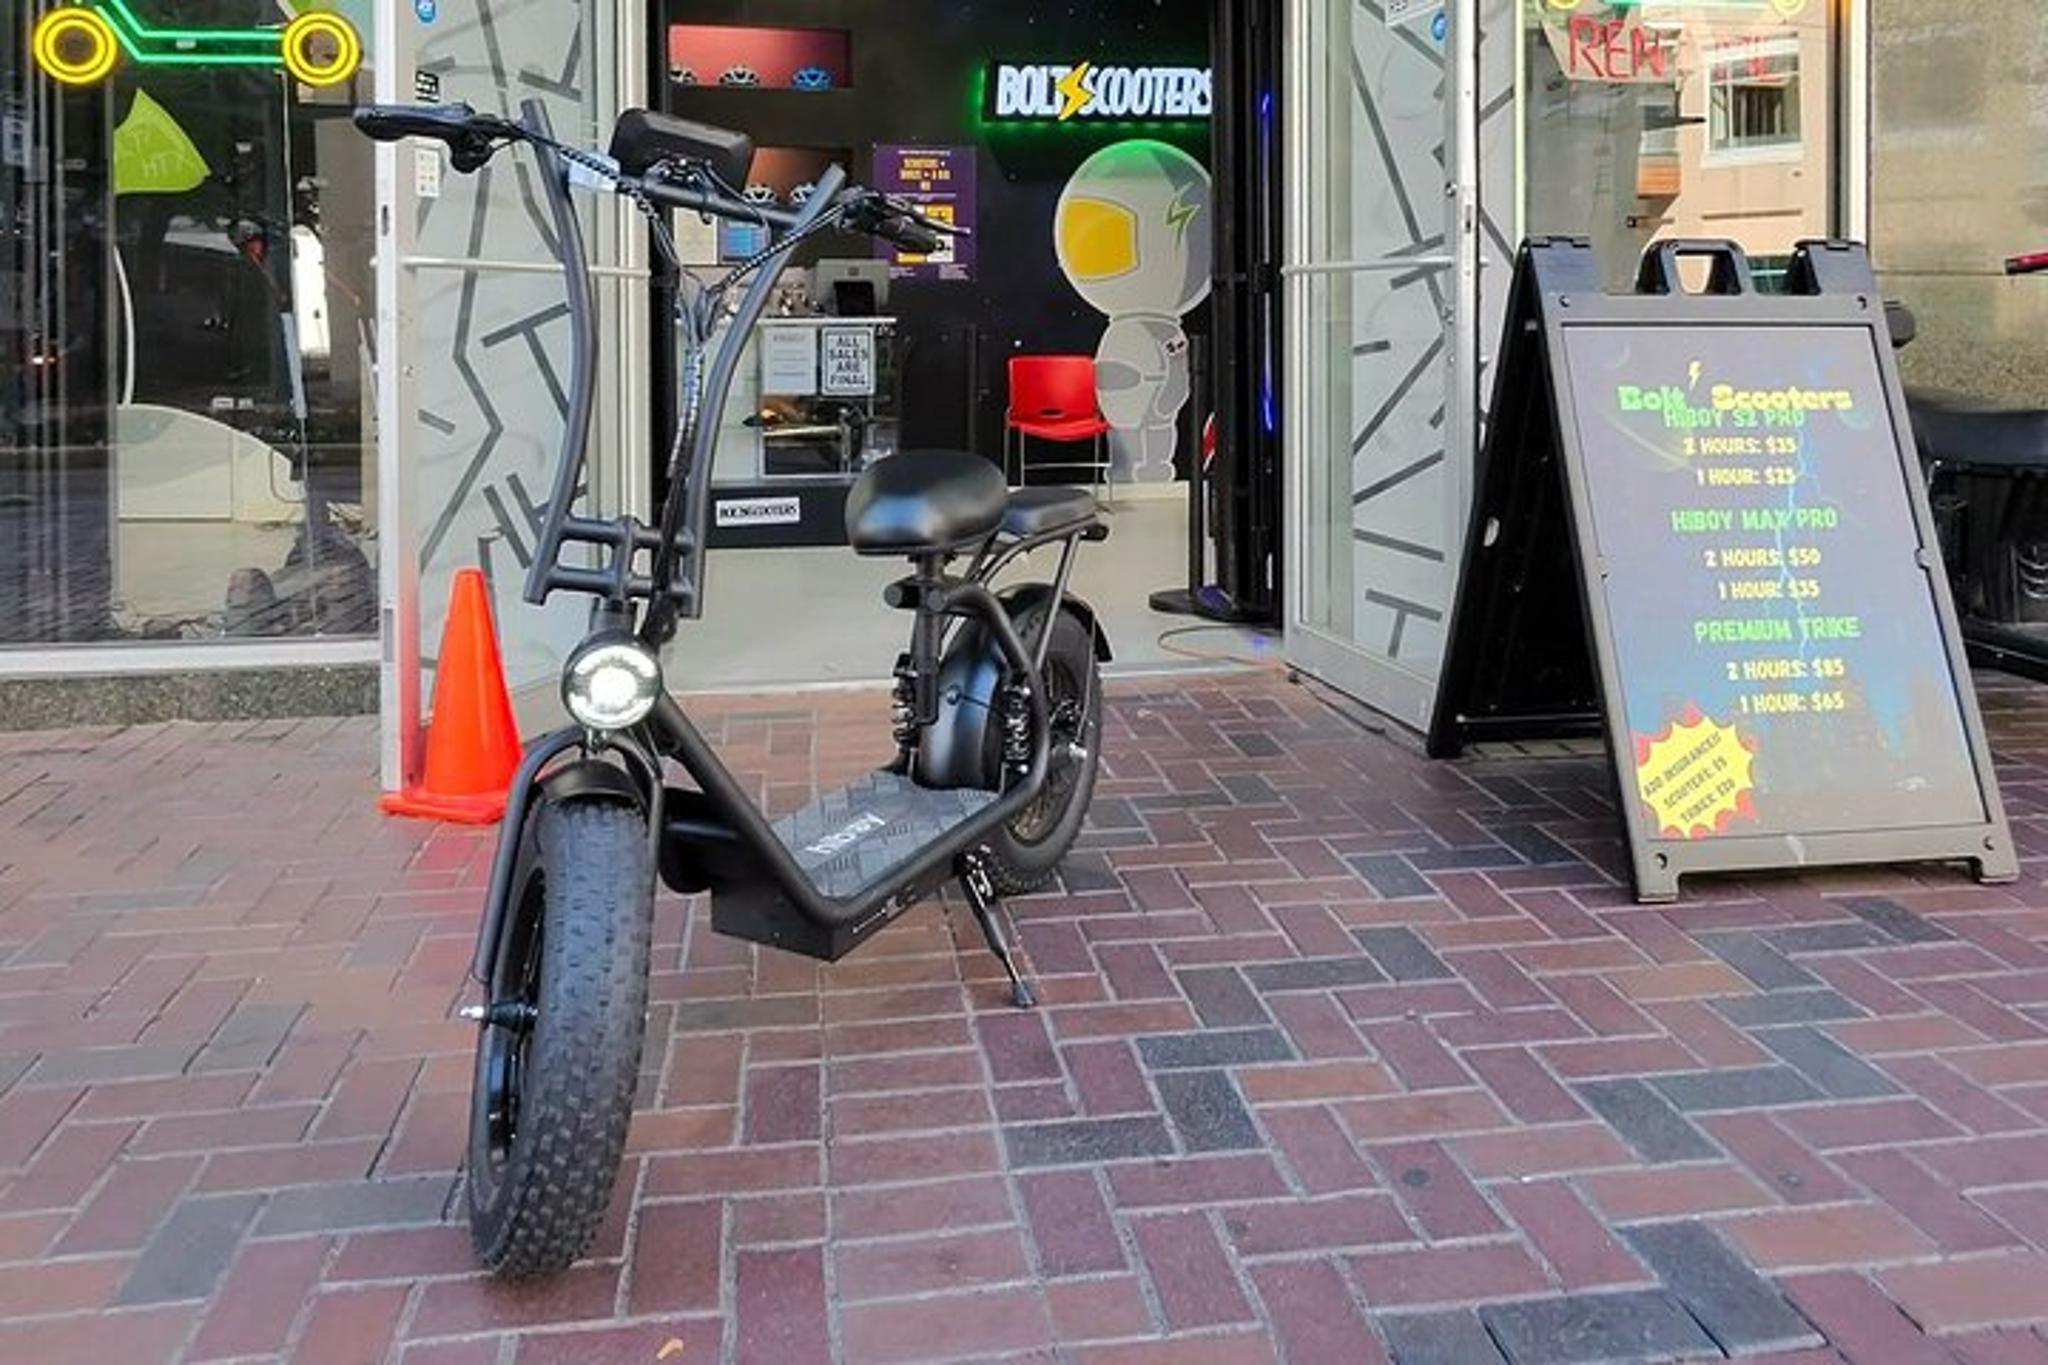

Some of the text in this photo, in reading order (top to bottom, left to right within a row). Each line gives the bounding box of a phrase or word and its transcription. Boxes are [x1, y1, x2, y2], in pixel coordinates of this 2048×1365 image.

[997, 65, 1213, 115] BOLT SCOOTERS
[836, 336, 860, 348] ALL
[836, 360, 861, 373] ARE
[1712, 383, 1852, 411] Scooters
[1700, 437, 1761, 455] HOURS:
[1697, 468, 1704, 485] 1
[1708, 467, 1761, 485] HOUR:
[1671, 506, 1839, 531] HIBOY MAX PRO
[1703, 547, 1822, 567] 2 HOURS: $50
[1718, 578, 1821, 600] 1 HOUR: $35
[1694, 616, 1862, 643] PREMIUM TRIKE
[1726, 662, 1739, 681] 2
[1743, 658, 1807, 681] HOURS:
[1740, 690, 1845, 713] 1 HOUR: $65
